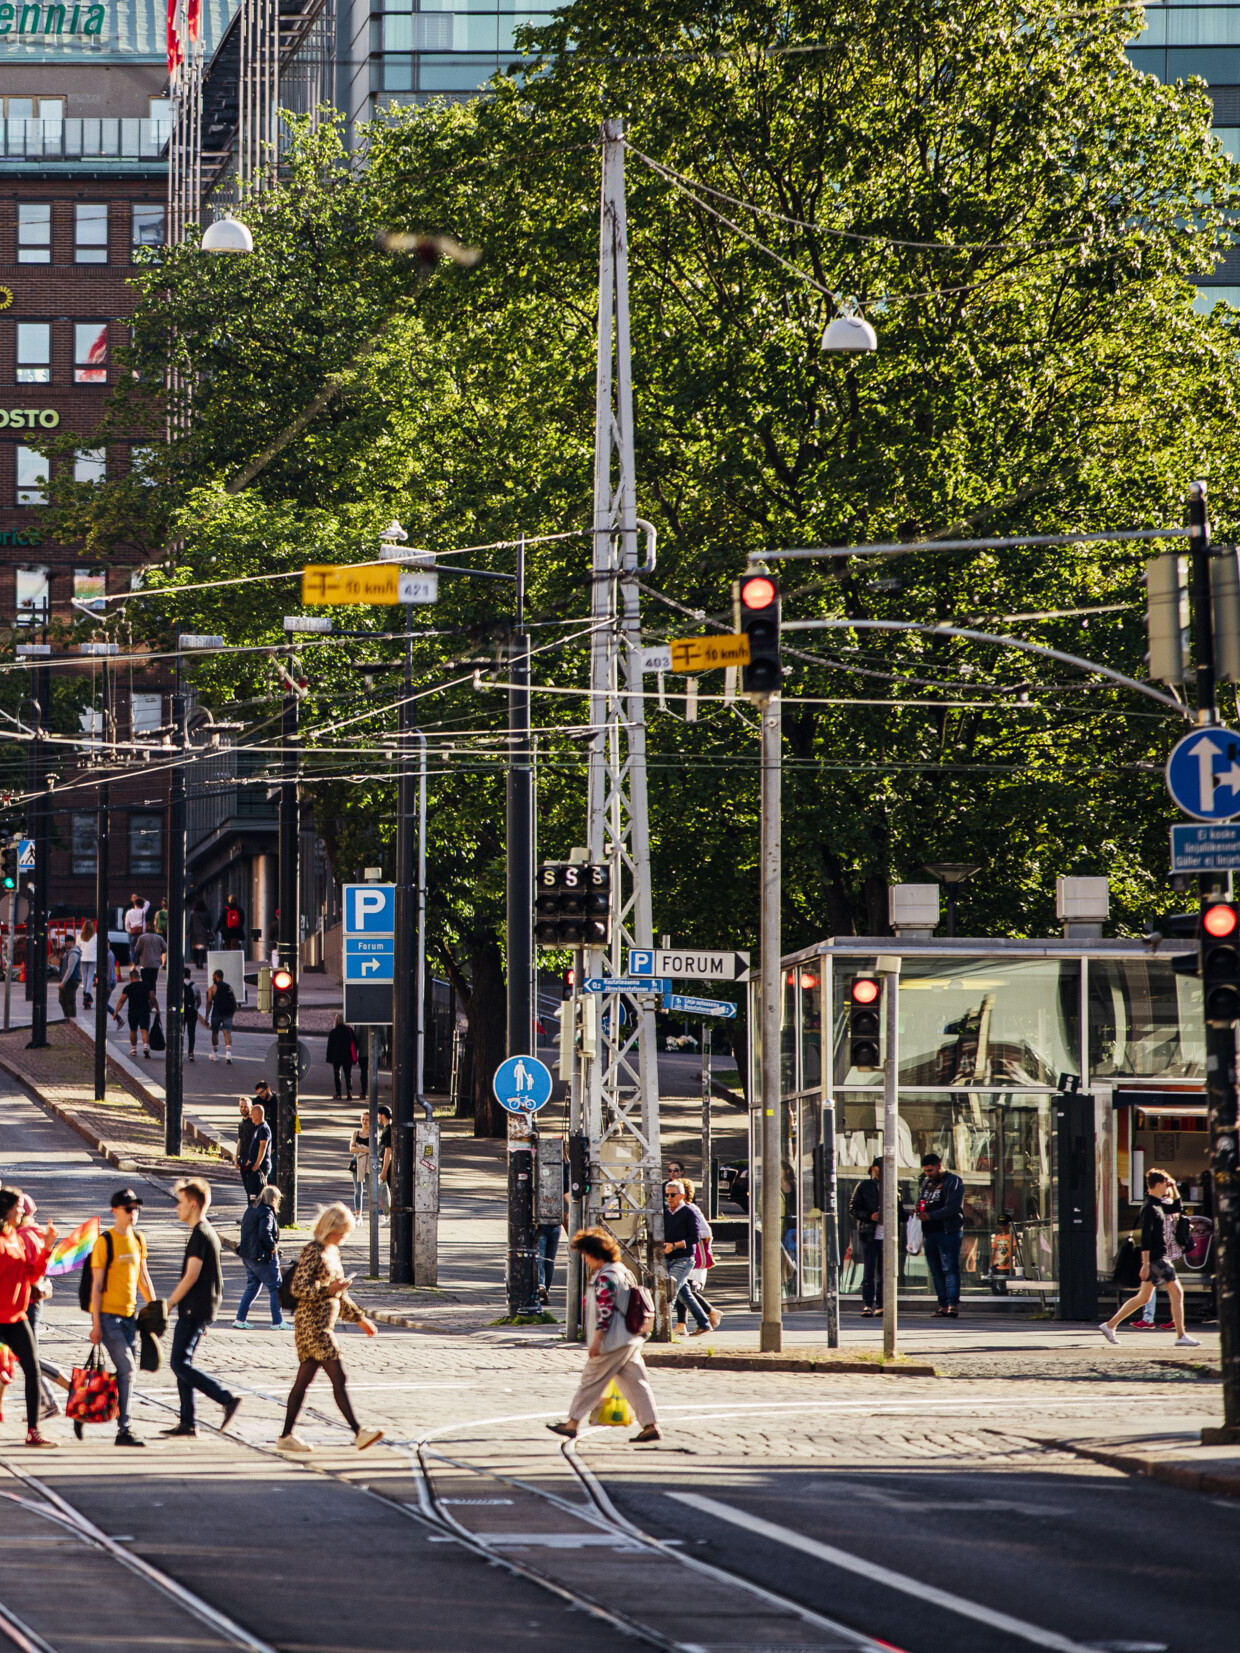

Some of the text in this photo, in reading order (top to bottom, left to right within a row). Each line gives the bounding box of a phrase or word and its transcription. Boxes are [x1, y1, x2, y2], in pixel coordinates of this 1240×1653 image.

[404, 584, 429, 597] 421
[705, 647, 749, 661] 10 km/h
[645, 656, 670, 668] 403
[543, 867, 603, 887] S S S
[355, 889, 387, 931] P
[358, 941, 384, 950] Forum
[634, 953, 724, 974] P FORUM
